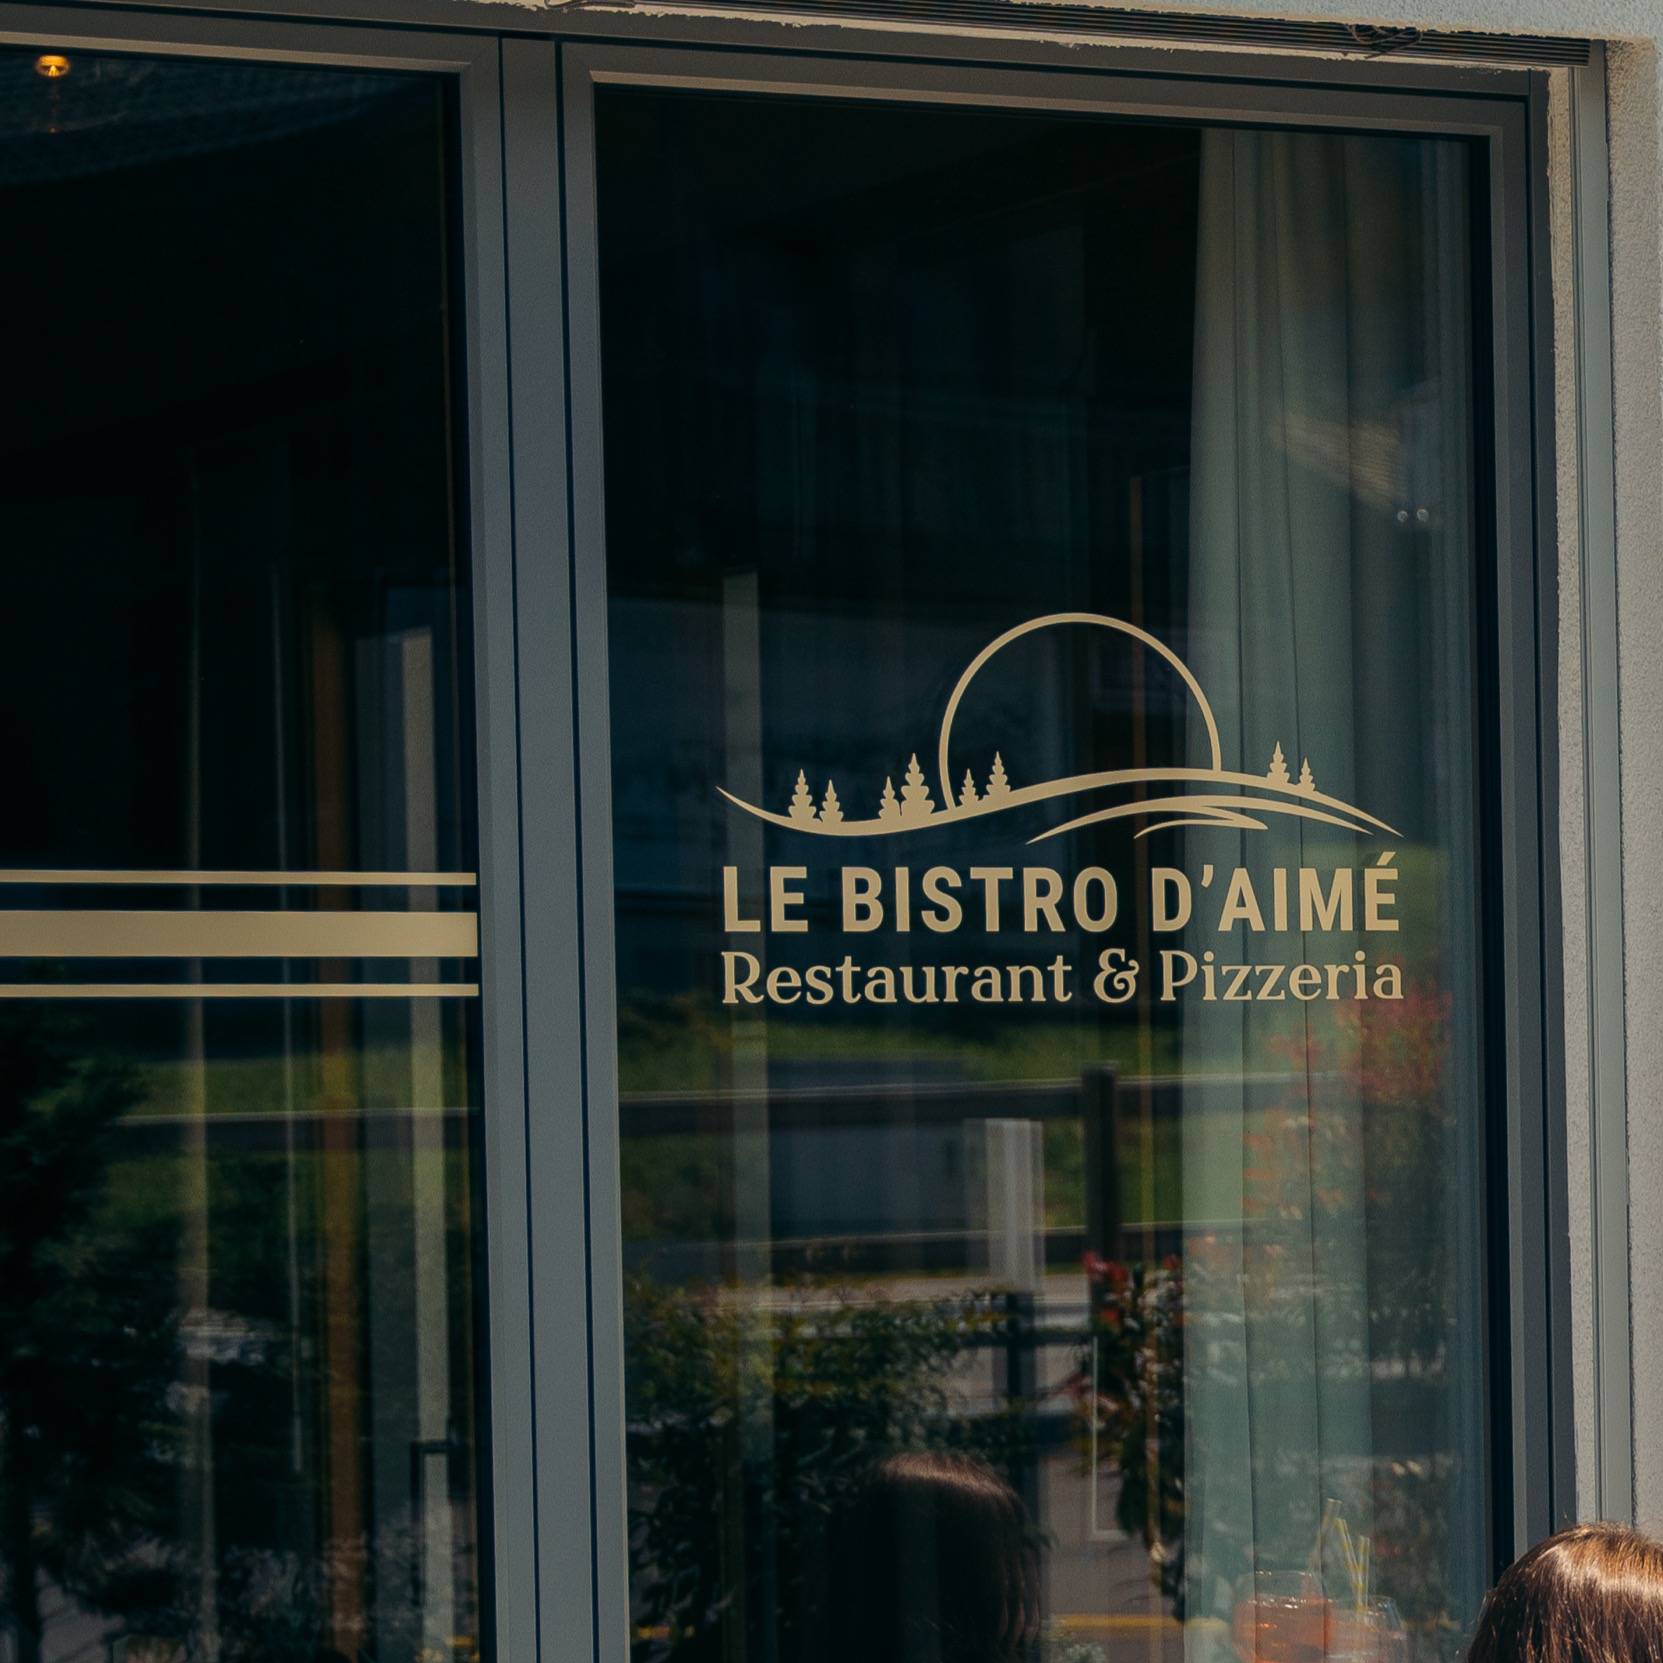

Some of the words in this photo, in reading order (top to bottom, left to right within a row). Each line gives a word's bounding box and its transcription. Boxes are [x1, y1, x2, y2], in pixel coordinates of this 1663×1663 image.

[723, 866, 808, 932] LE
[842, 867, 1117, 932] BISTRO
[1151, 852, 1400, 932] D'AIMÉ
[721, 951, 1072, 1004] Restaurant
[1094, 949, 1140, 1003] &
[1160, 950, 1404, 1001] Pizzeria
